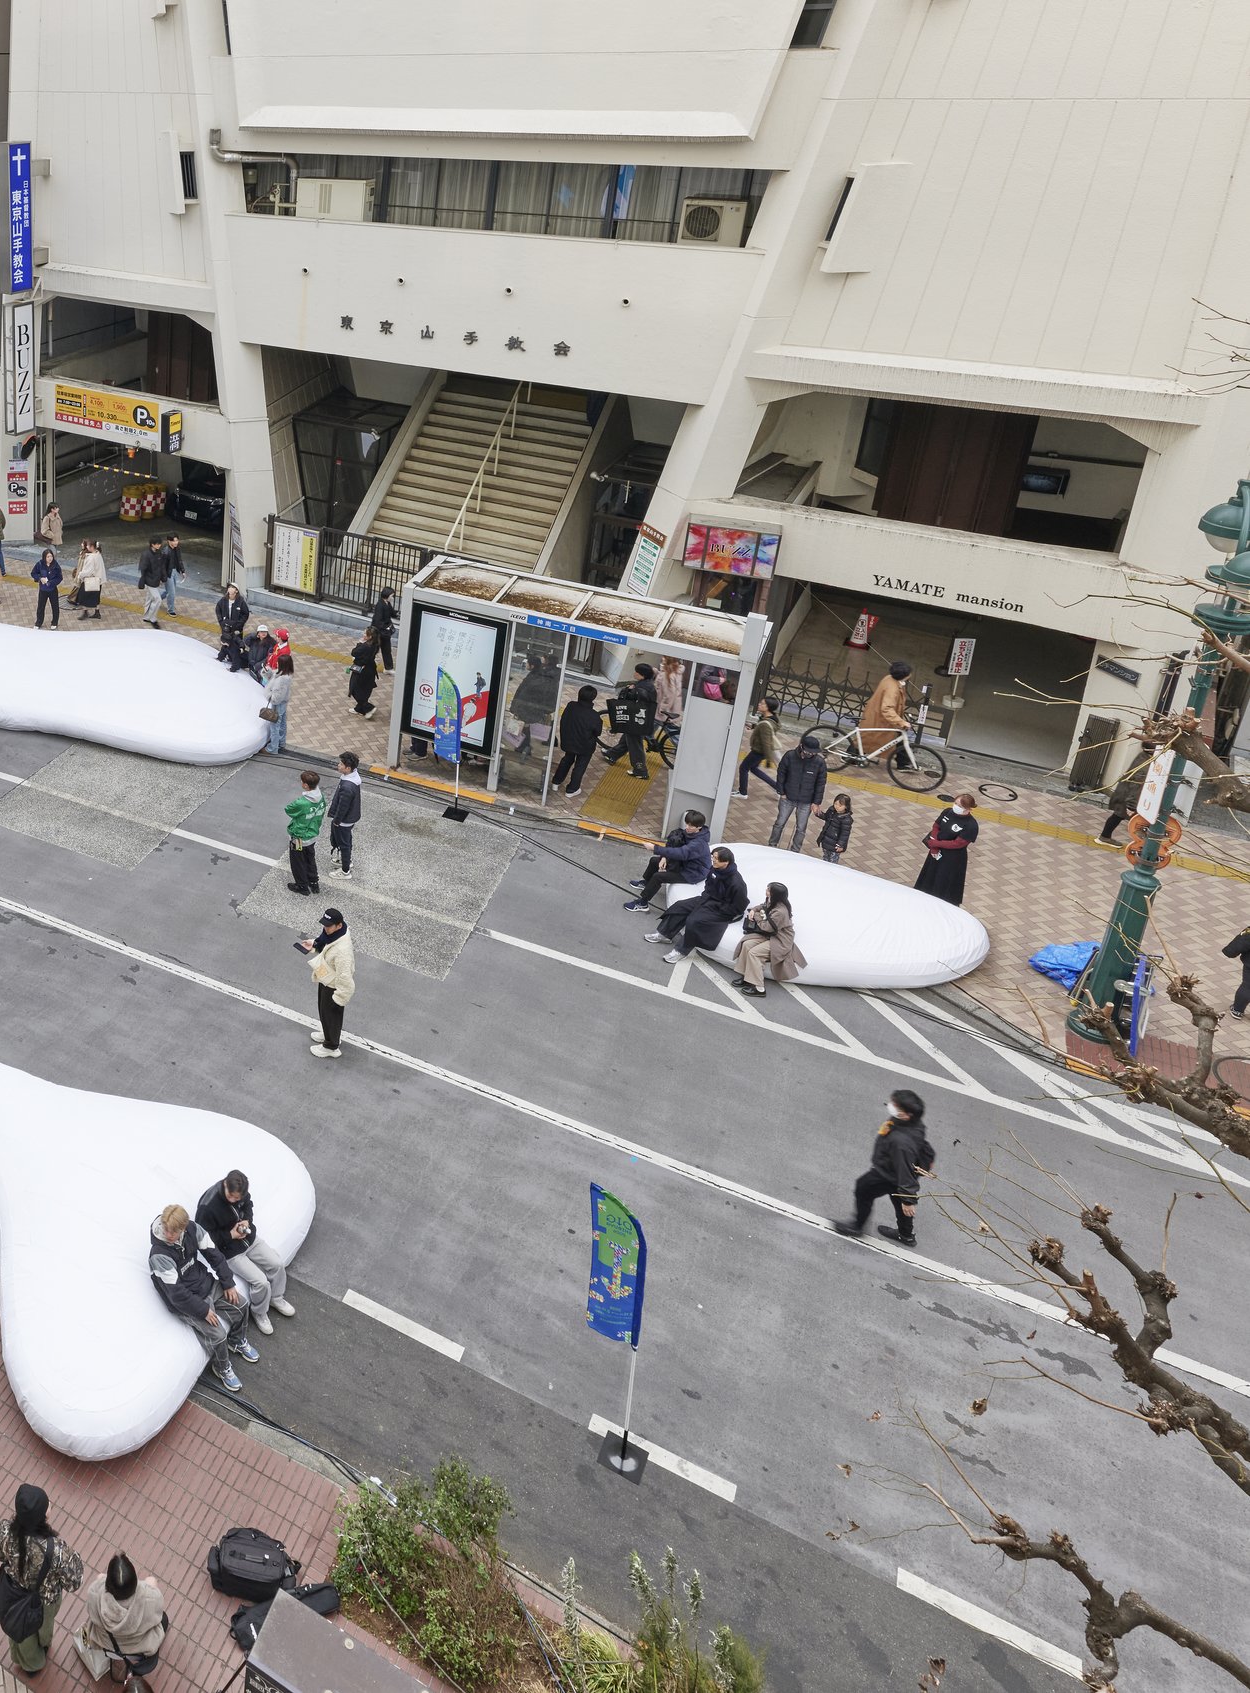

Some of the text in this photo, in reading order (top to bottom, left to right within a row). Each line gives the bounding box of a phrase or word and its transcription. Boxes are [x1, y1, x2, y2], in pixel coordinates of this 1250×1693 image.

[12, 190, 24, 284] 東京山手教会
[340, 314, 572, 357] 東京山手教会
[16, 325, 31, 416] BUZZ
[136, 408, 148, 424] P
[11, 483, 18, 492] P
[872, 574, 1025, 614] YAMATE mansion
[510, 613, 527, 622] KEIO
[536, 618, 577, 634] 神南一丁目
